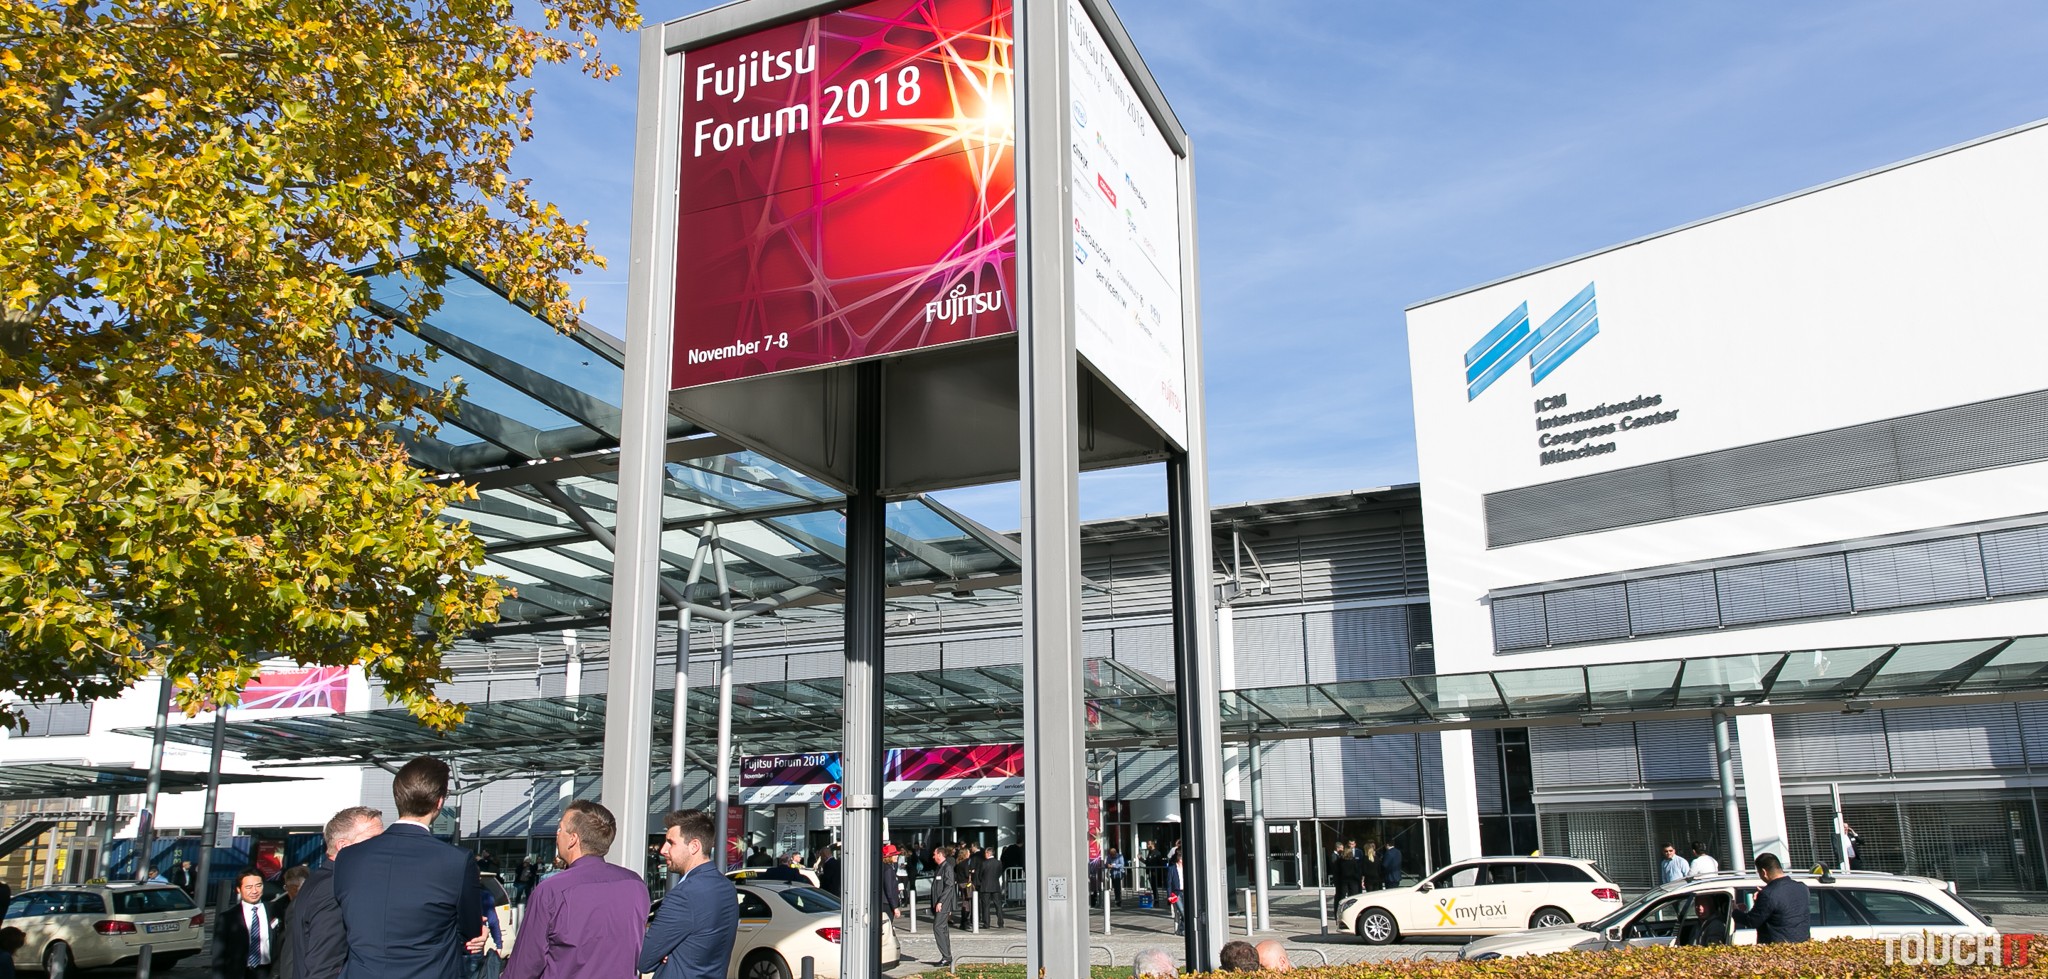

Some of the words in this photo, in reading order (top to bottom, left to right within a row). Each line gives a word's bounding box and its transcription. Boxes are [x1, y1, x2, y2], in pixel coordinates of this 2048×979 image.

[696, 45, 816, 103] Fujitsu
[1069, 4, 1099, 65] Fujitsu
[1099, 52, 1126, 108] Forum
[1126, 94, 1146, 138] 2018
[694, 103, 809, 158] Forum
[821, 64, 921, 127] 2018
[1080, 225, 1111, 267] BROADCOM
[924, 284, 1002, 325] FUJITSU
[688, 338, 760, 365] November
[763, 332, 789, 354] 7-8
[1534, 393, 1567, 413] ICM
[1536, 393, 1663, 431] Internationales
[1538, 421, 1617, 448] Congress
[1618, 408, 1680, 432] Center
[1540, 441, 1616, 466] München
[744, 758, 772, 772] Fujitsu
[774, 757, 801, 768] Forum
[803, 755, 826, 767] 2018
[1455, 900, 1508, 922] mytaxi
